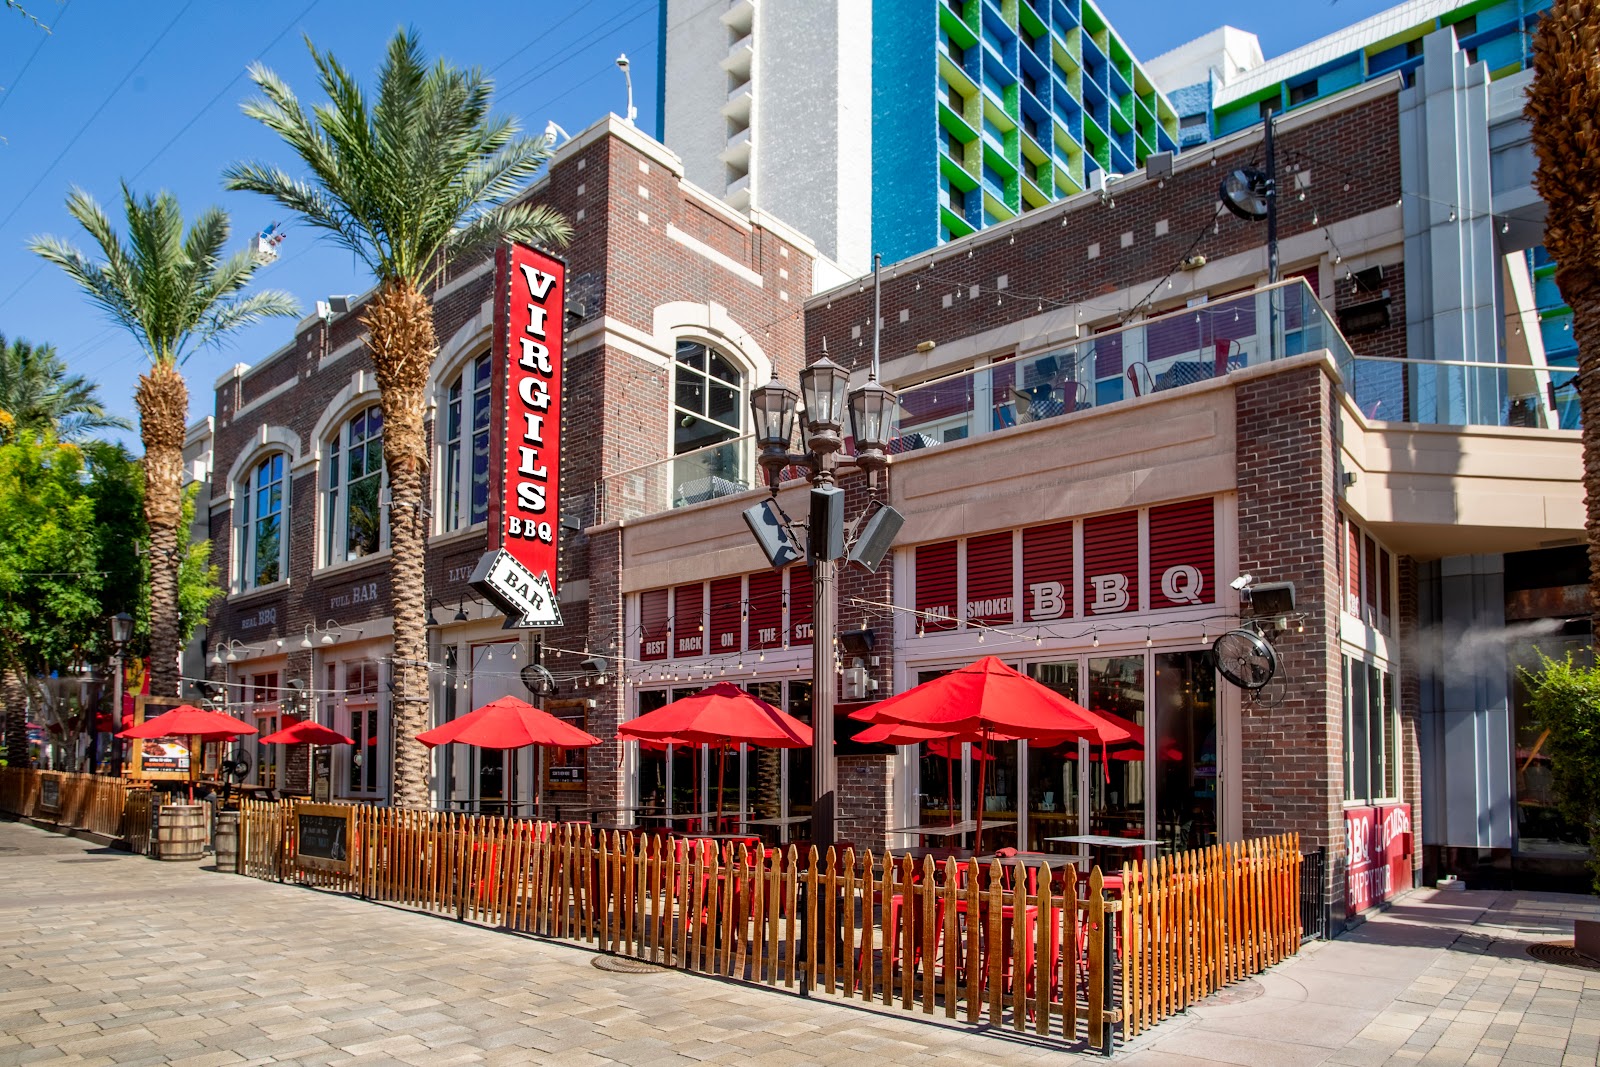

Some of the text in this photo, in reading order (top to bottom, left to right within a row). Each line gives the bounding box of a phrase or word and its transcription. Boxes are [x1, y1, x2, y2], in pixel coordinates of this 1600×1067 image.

[518, 262, 556, 514] VIRGILS
[508, 515, 552, 544] BBQ
[330, 582, 378, 609] FULL BAR
[504, 569, 544, 611] BAR
[258, 608, 277, 626] BBQ
[967, 597, 1013, 618] SMOKED
[646, 640, 666, 655] BEST
[679, 636, 702, 651] RACK
[721, 633, 734, 647] ON
[758, 627, 776, 643] THE
[1345, 816, 1370, 866] BBQ
[1348, 864, 1391, 906] HAPPY HOUR
